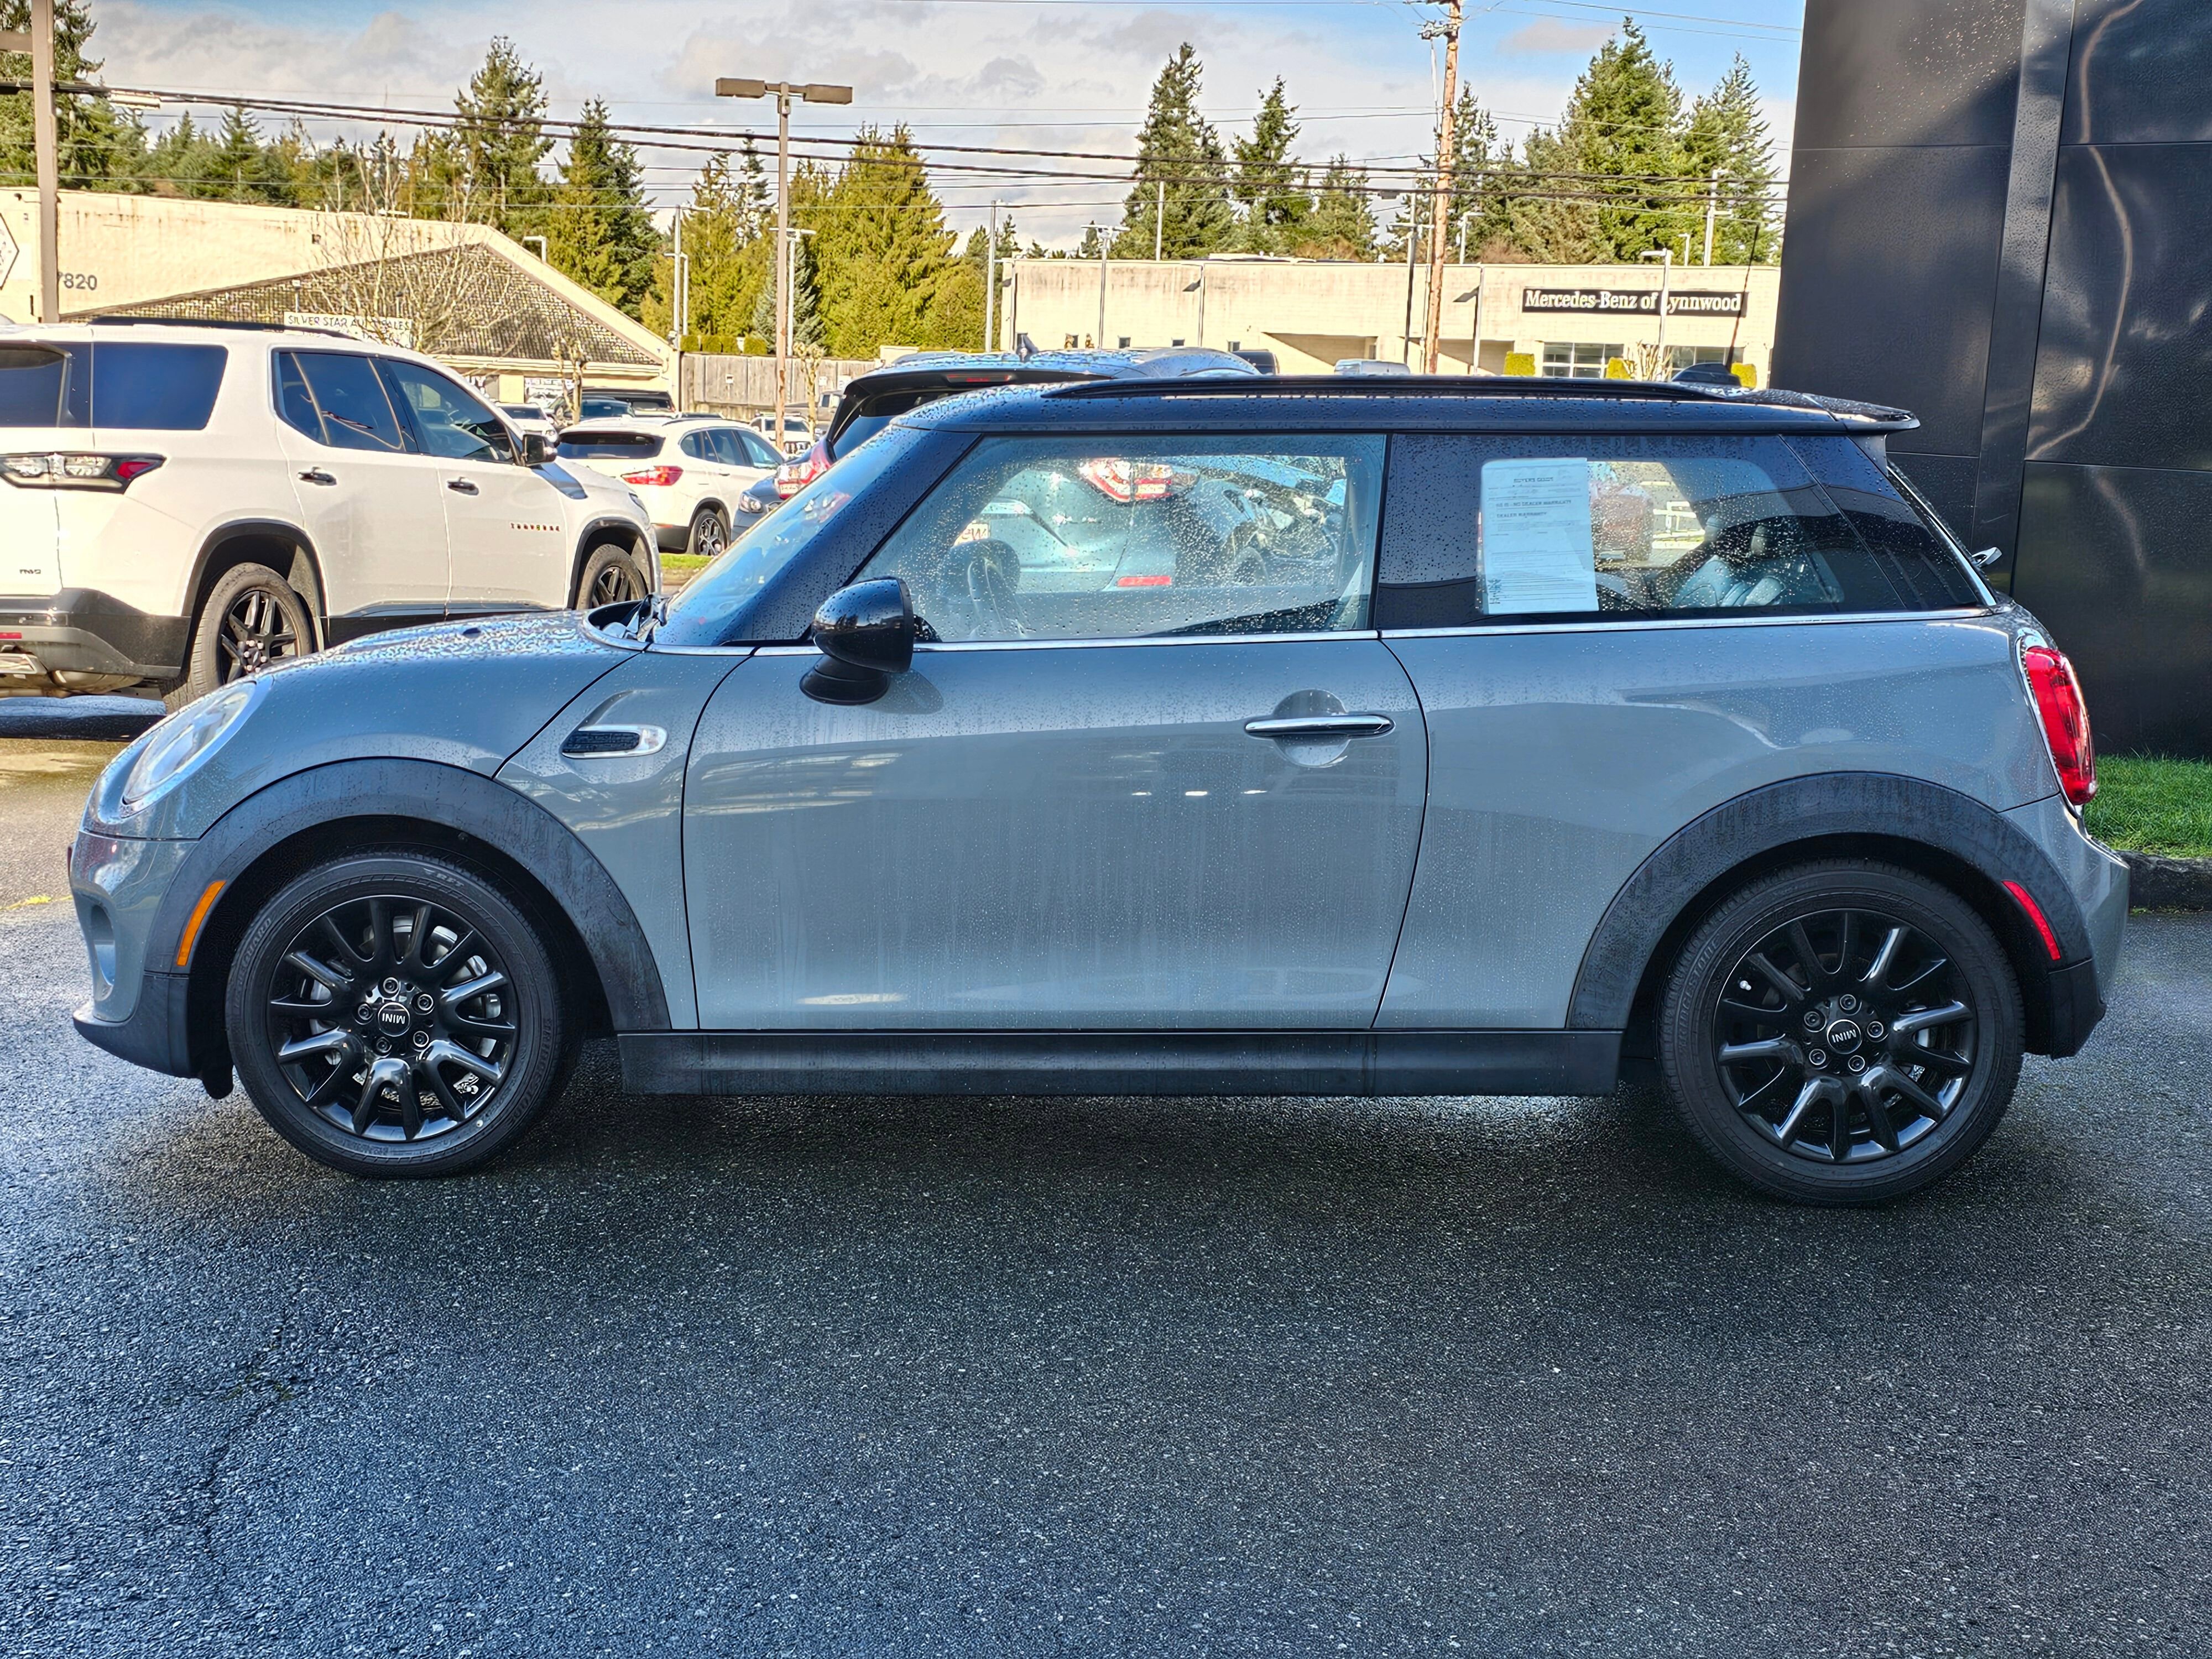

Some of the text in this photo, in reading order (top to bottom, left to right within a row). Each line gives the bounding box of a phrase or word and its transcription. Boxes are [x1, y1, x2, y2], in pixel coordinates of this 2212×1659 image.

[1526, 290, 1742, 314] Mercedes-Benz of ynnwood
[323, 317, 348, 327] STAR
[382, 1013, 406, 1024] MINI
[1832, 1029, 1857, 1043] MINI
